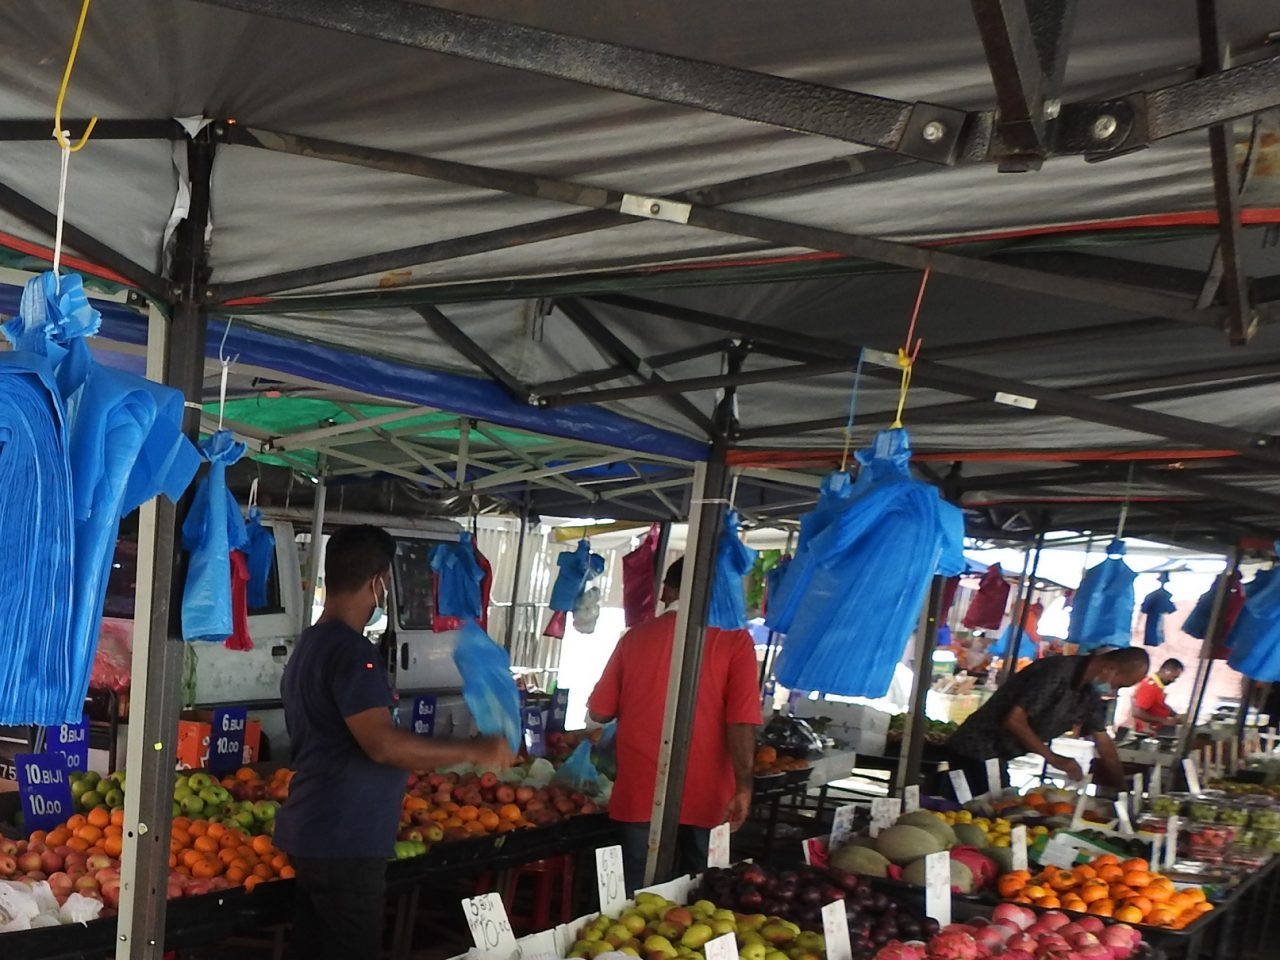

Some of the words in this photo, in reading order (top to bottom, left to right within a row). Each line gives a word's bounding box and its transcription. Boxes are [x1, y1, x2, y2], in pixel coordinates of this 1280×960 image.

[216, 736, 240, 754] 10.00
[24, 763, 64, 785] 10.BIJI
[28, 794, 62, 815] 10.00
